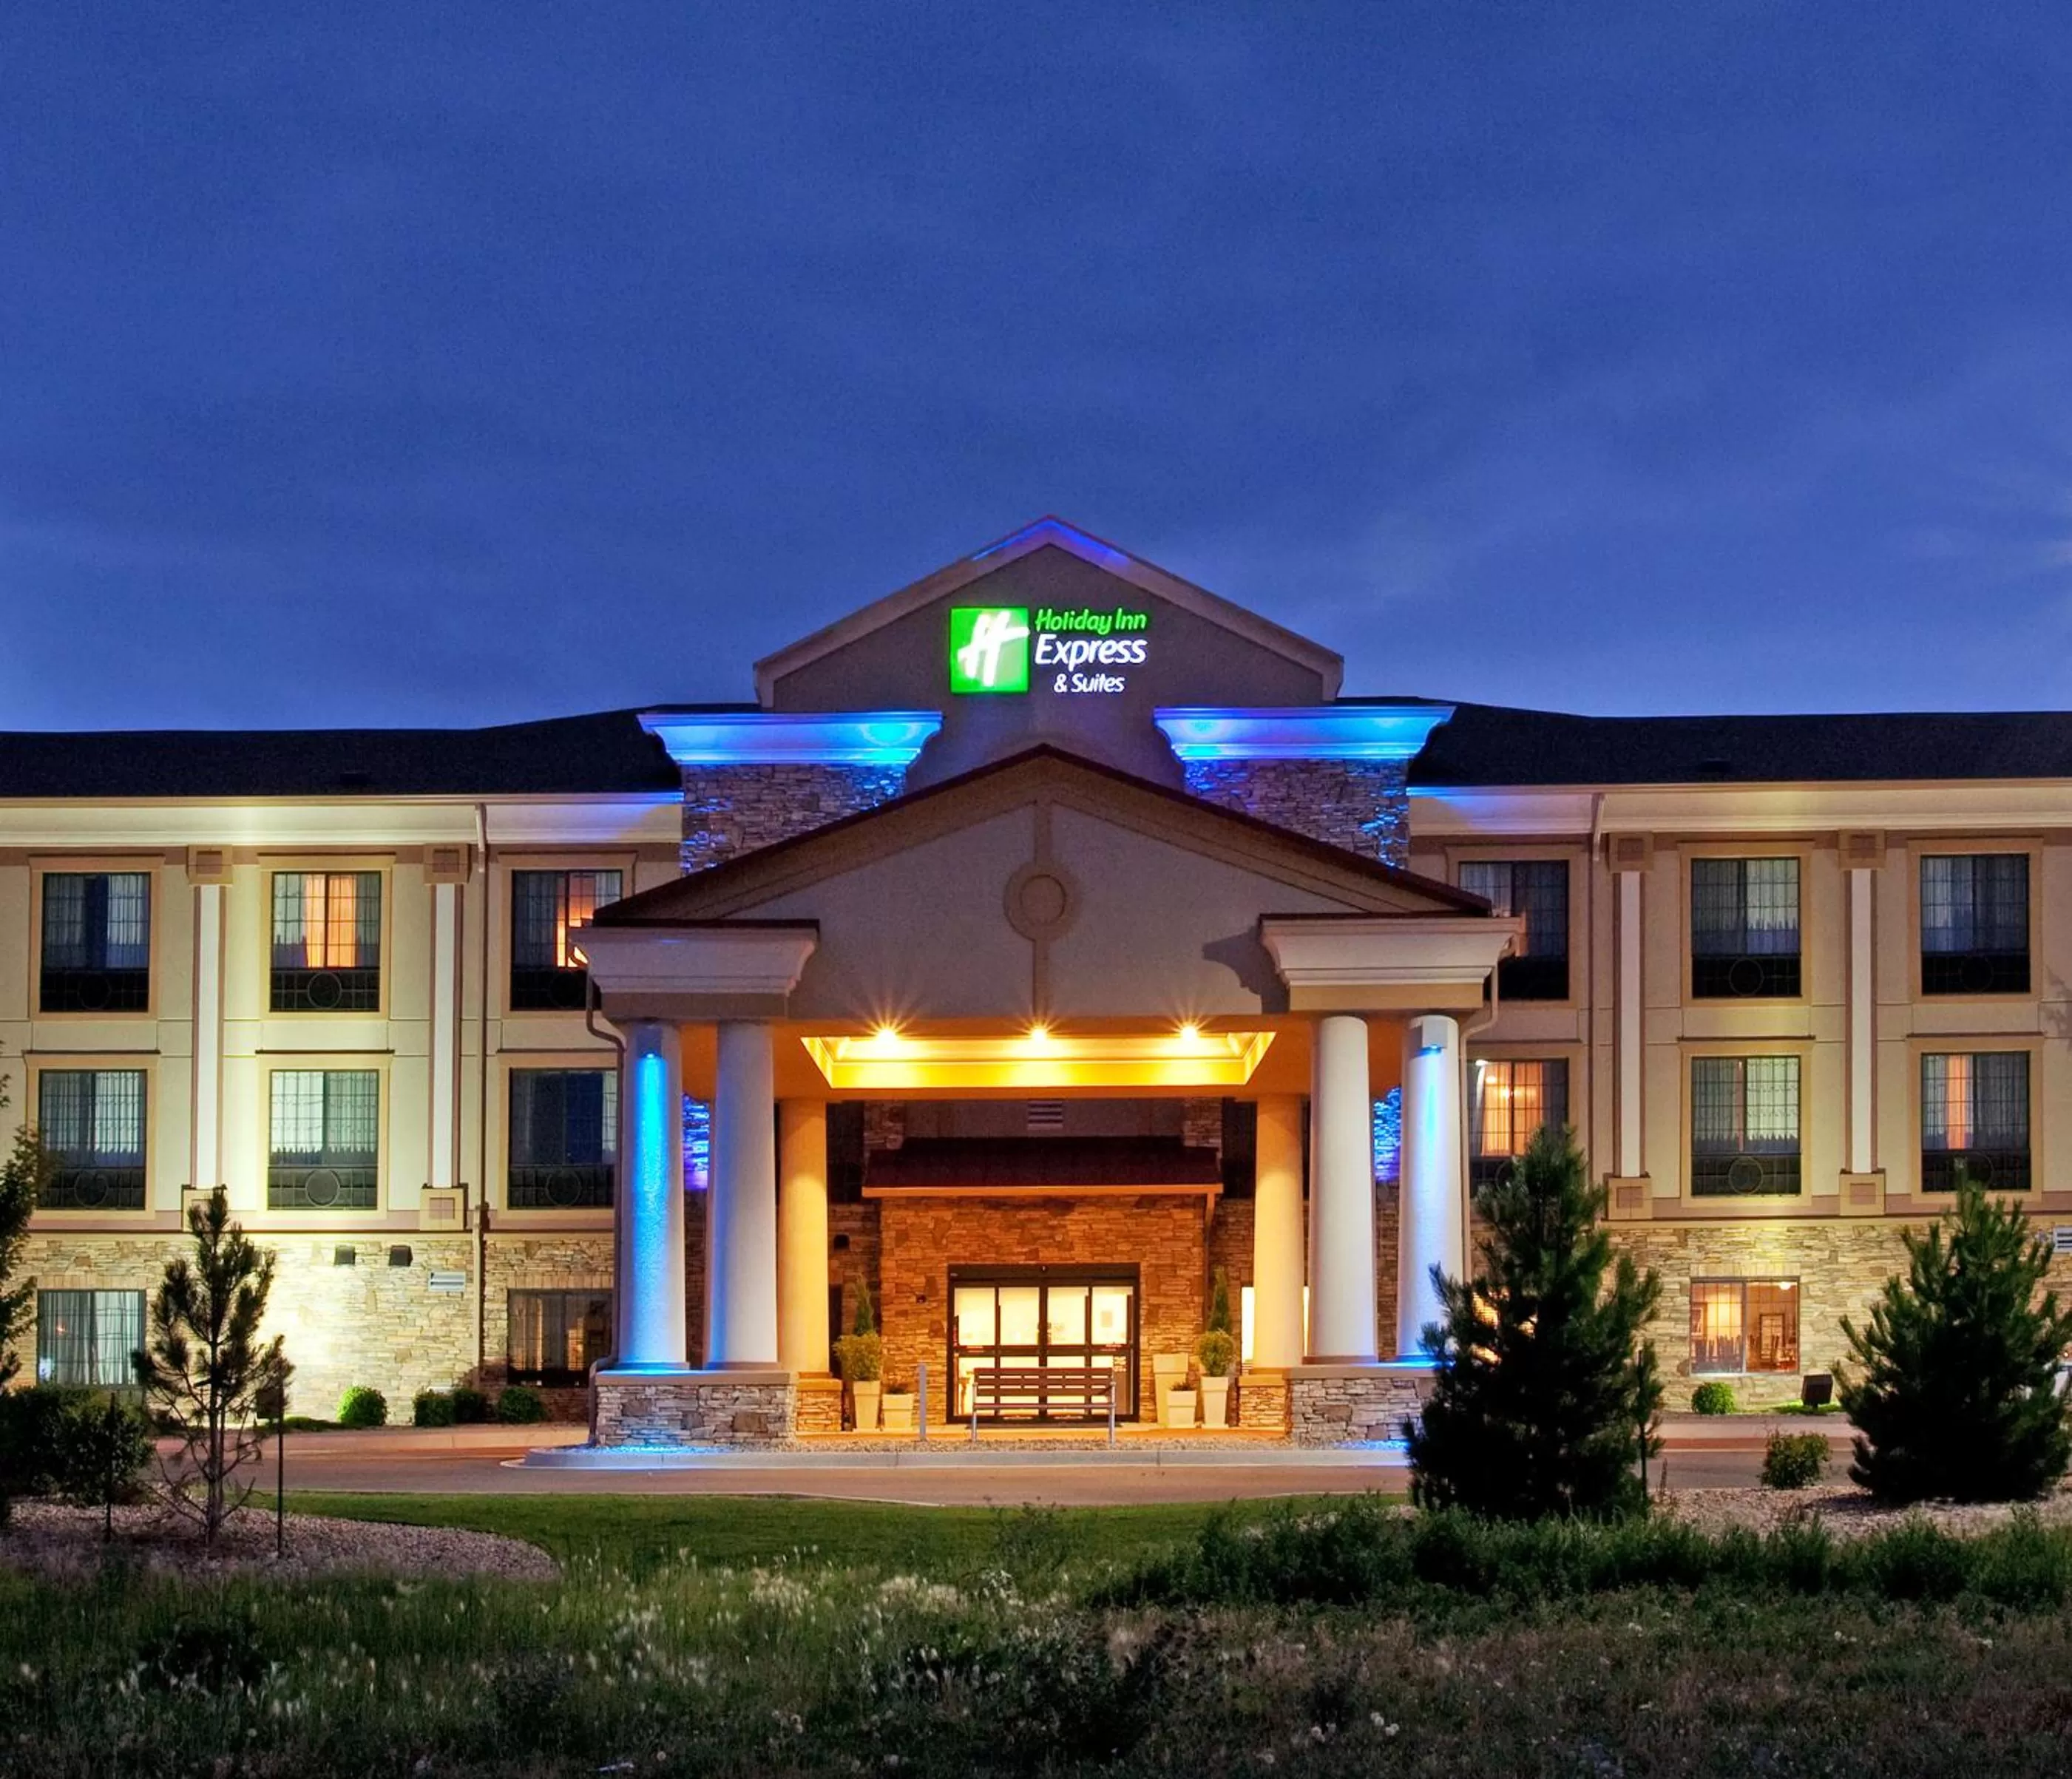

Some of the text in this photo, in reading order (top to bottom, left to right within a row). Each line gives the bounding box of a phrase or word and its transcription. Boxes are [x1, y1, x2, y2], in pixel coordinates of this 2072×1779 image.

[1035, 608, 1146, 634] Holiday Inn
[1035, 634, 1148, 671] Express
[1054, 674, 1125, 693] & Suites
